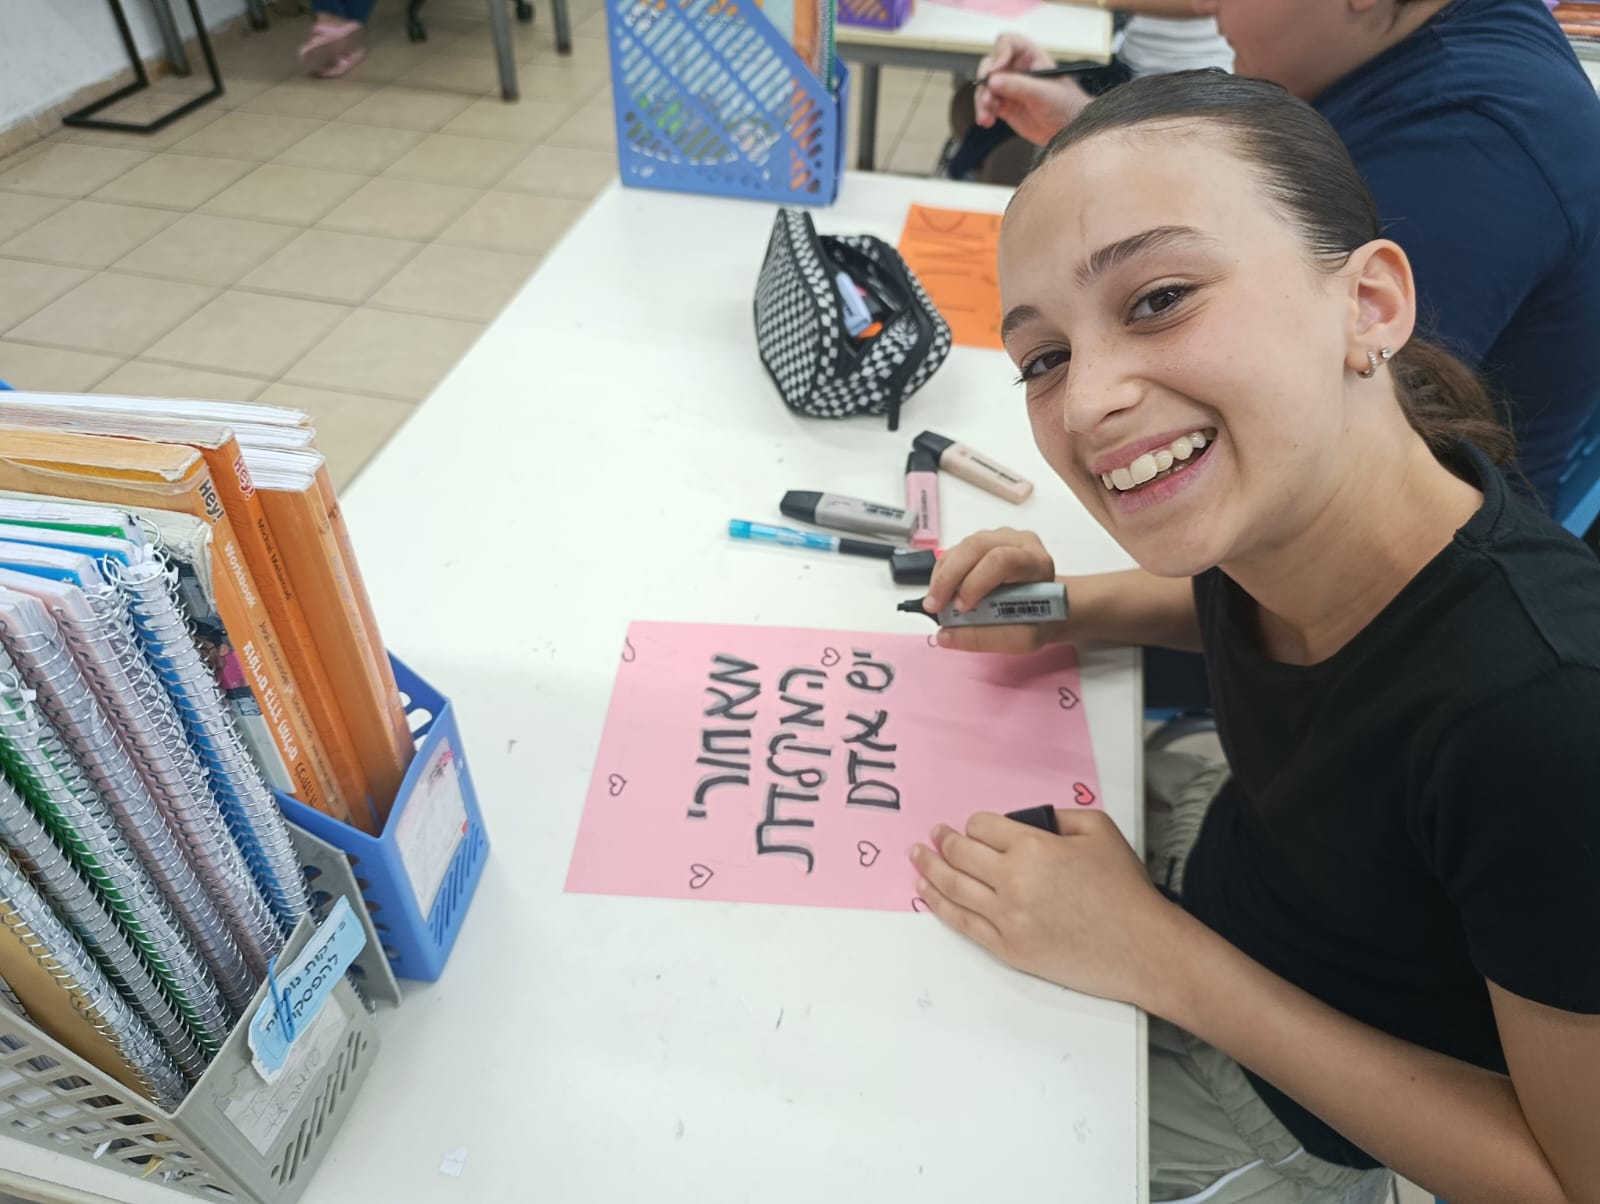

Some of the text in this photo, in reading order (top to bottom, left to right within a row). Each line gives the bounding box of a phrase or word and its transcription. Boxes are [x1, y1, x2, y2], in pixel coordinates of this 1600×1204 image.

[199, 479, 225, 523] Hey!
[233, 455, 256, 500] Hey!
[225, 541, 257, 608] Workbook
[687, 653, 761, 821] מאחורי
[843, 650, 901, 811] יש אדם
[756, 665, 832, 874] המקלדת
[304, 932, 338, 976] דקות
[265, 976, 302, 1033] נוסות
